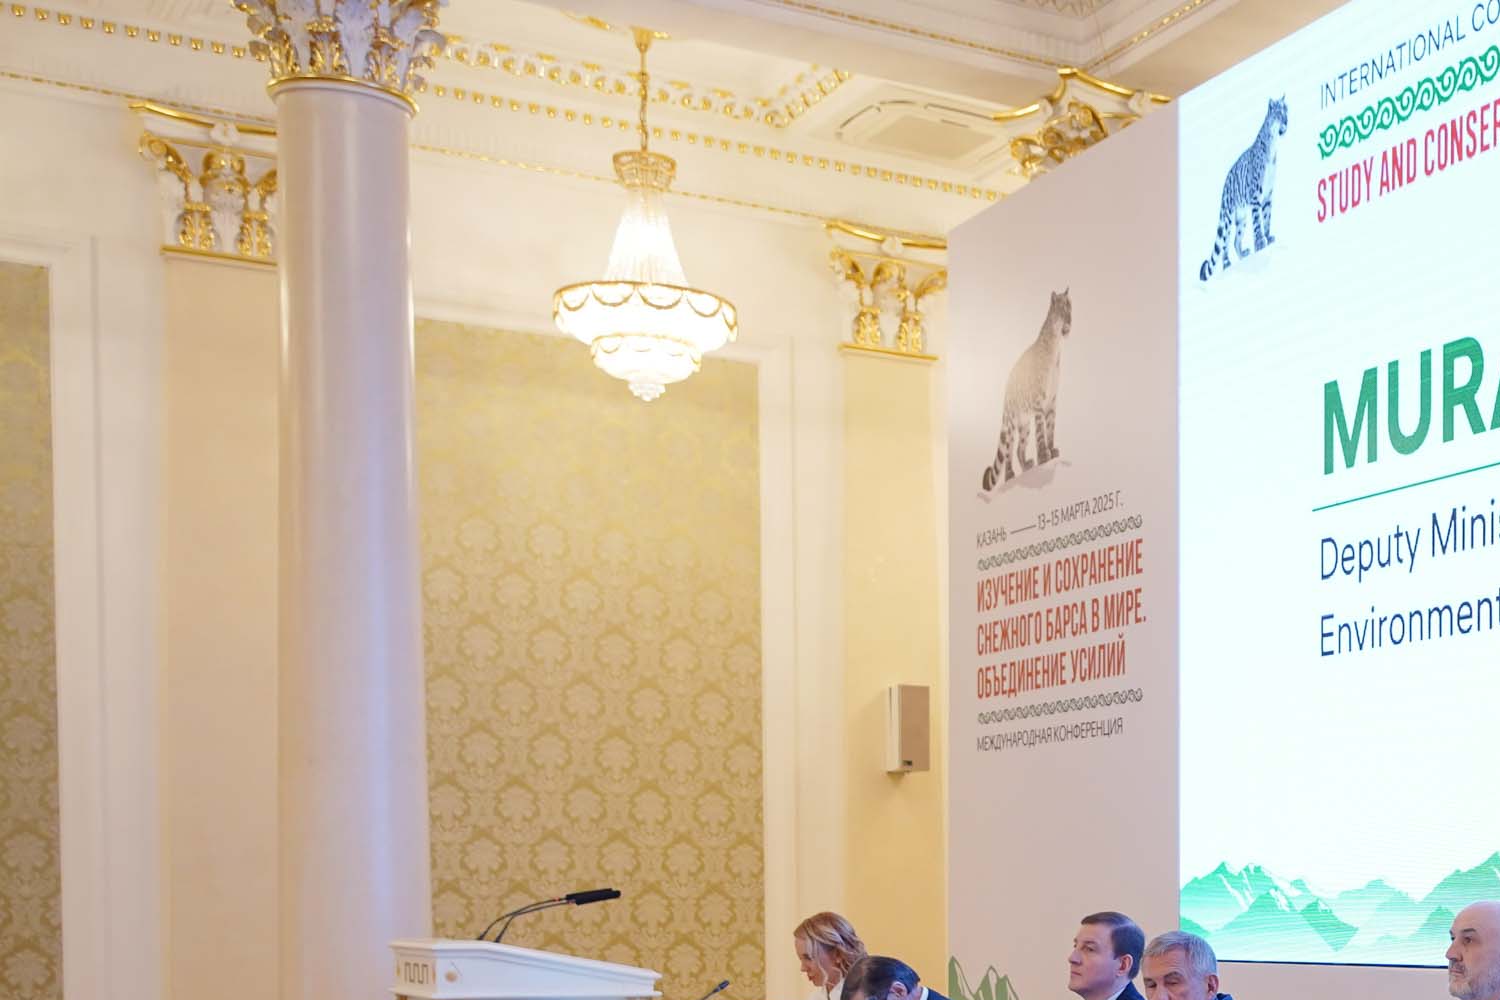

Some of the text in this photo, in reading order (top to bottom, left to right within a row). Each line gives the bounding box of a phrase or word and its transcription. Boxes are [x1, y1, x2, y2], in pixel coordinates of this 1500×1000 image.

[1320, 15, 1467, 110] INTERNATIONAL
[1316, 156, 1374, 224] STUDY
[1378, 138, 1417, 197] AND
[976, 526, 1008, 549] КАЗАНЬ
[1060, 500, 1091, 522] МАРТА
[1091, 493, 1114, 515] 2025
[1320, 524, 1422, 584] Deputy
[977, 538, 1143, 612] ИЗУЧЕНИЕ И СОХРАНЕНИЕ
[977, 588, 1147, 656] СНЕЖНОГО БАРСА В МИРЕ.
[977, 632, 1126, 699] ОБЪЕДИНЕНИЕ УСИЛИЙ
[976, 717, 1124, 752] МЕЖДУНАРОДНАЯ КОНФЕРЕНЦИЯ
